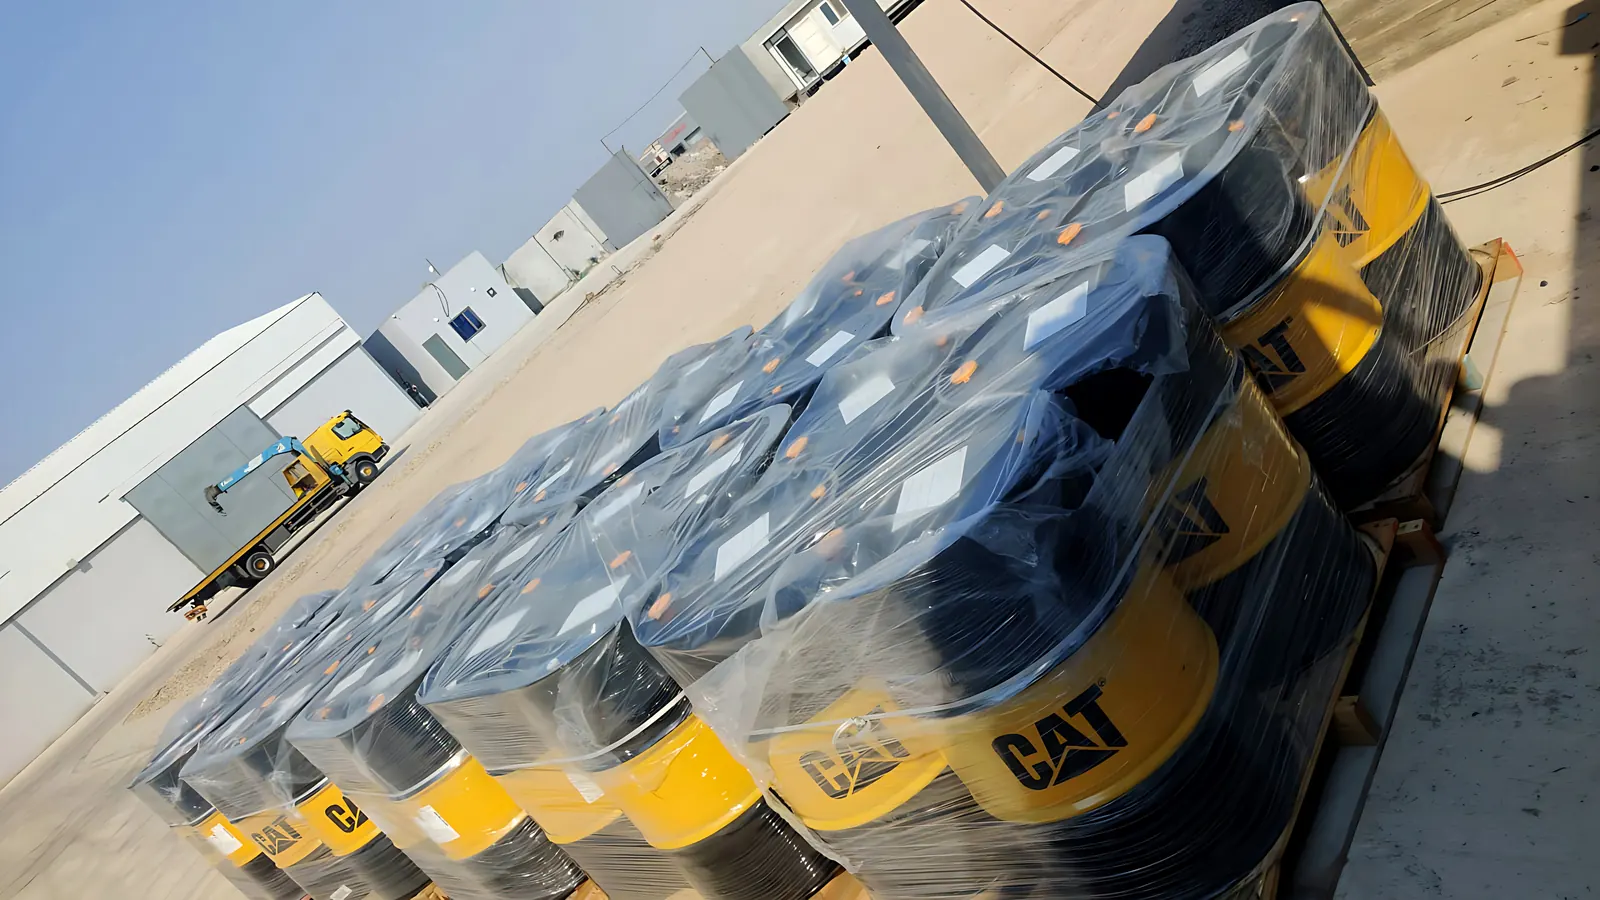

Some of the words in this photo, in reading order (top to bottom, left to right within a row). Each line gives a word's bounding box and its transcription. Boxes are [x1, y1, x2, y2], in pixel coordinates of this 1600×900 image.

[1240, 320, 1306, 394] AT
[799, 705, 911, 799] CAT
[992, 683, 1128, 790] CAT
[251, 815, 302, 855] CAT
